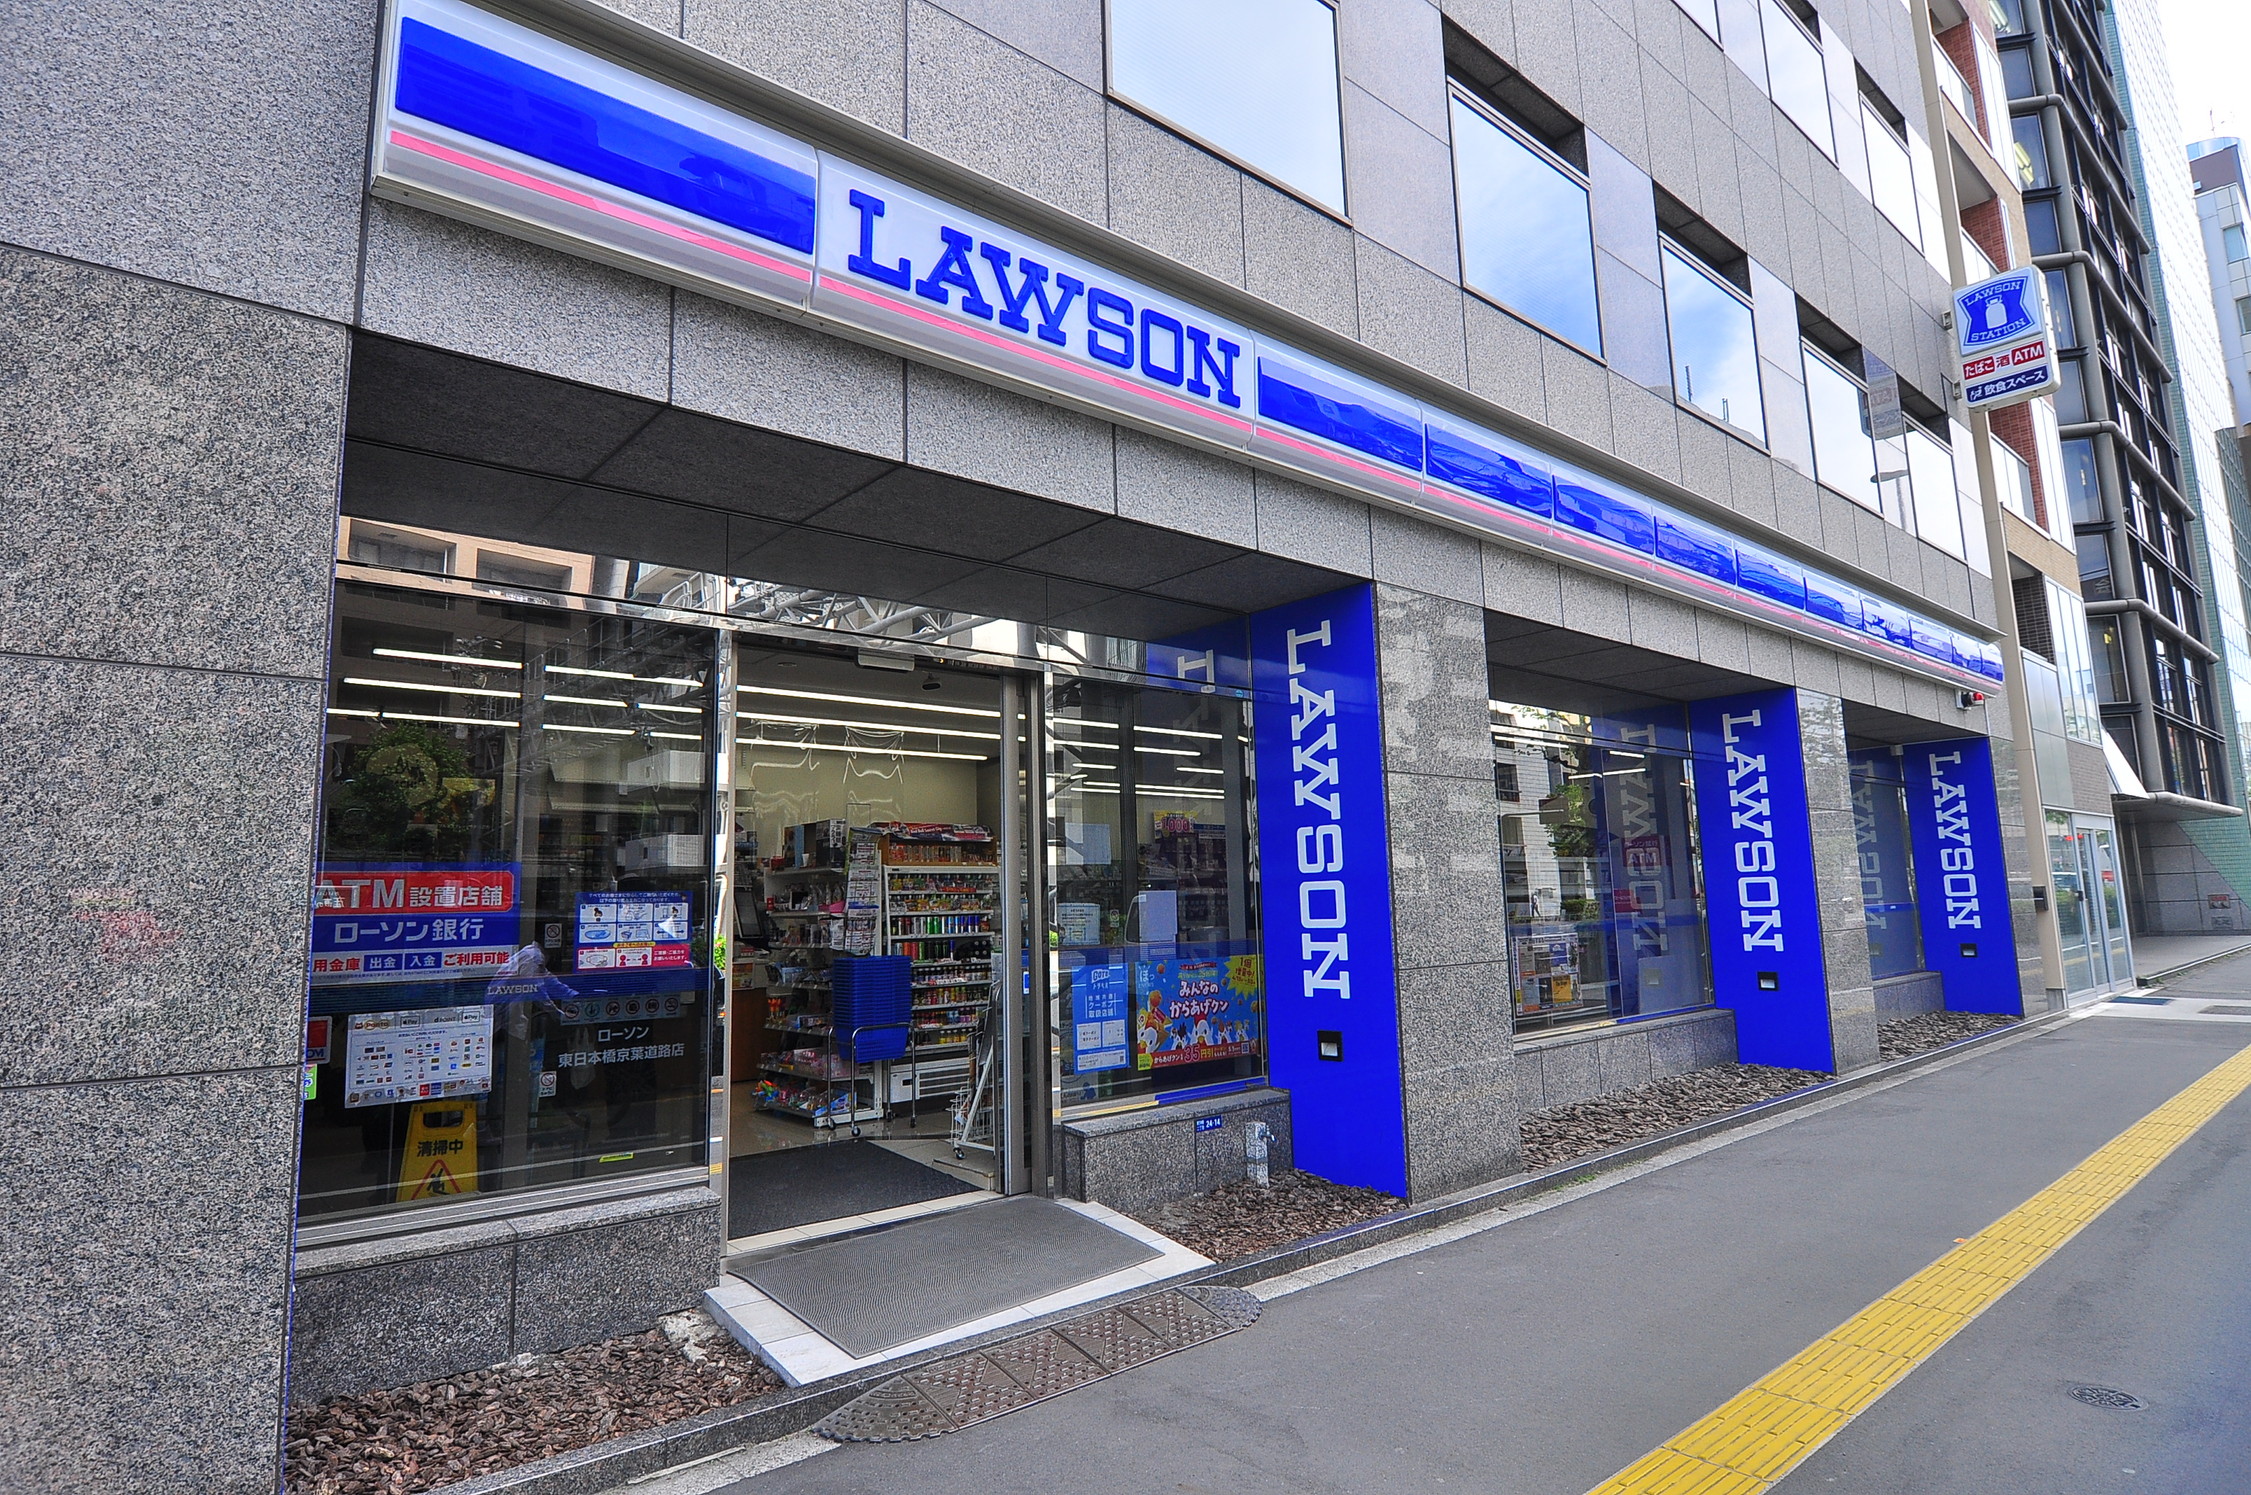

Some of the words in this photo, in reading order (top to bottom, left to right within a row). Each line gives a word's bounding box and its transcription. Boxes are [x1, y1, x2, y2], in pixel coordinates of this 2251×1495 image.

[848, 188, 1241, 408] LAWSON
[1964, 280, 2022, 306] LAWSON
[1971, 318, 2027, 342] STATION
[1965, 360, 1995, 378] たばこ
[2014, 345, 2043, 363] ATM
[1984, 370, 2046, 396] 飲食スペース
[1286, 619, 1351, 1000] LAWSON
[1722, 709, 1784, 951] LAWSON
[1929, 751, 1982, 929] LAWSON
[1629, 853, 1657, 864] ATM
[316, 879, 405, 909] ATM
[409, 885, 503, 908] 設置店舗
[334, 918, 485, 944] ローソン銀行
[369, 956, 396, 969] 出金
[409, 954, 436, 967] 入金
[443, 952, 509, 966] ご利用可能
[487, 984, 538, 995] LAWSON
[1179, 980, 1219, 998] みんなの
[1169, 999, 1229, 1019] からあげクン
[598, 1026, 650, 1042] ローソン
[558, 1043, 685, 1068] 東日本橋京葉道路店
[1184, 1044, 1200, 1063] 35
[417, 1138, 464, 1157] 清掃中
